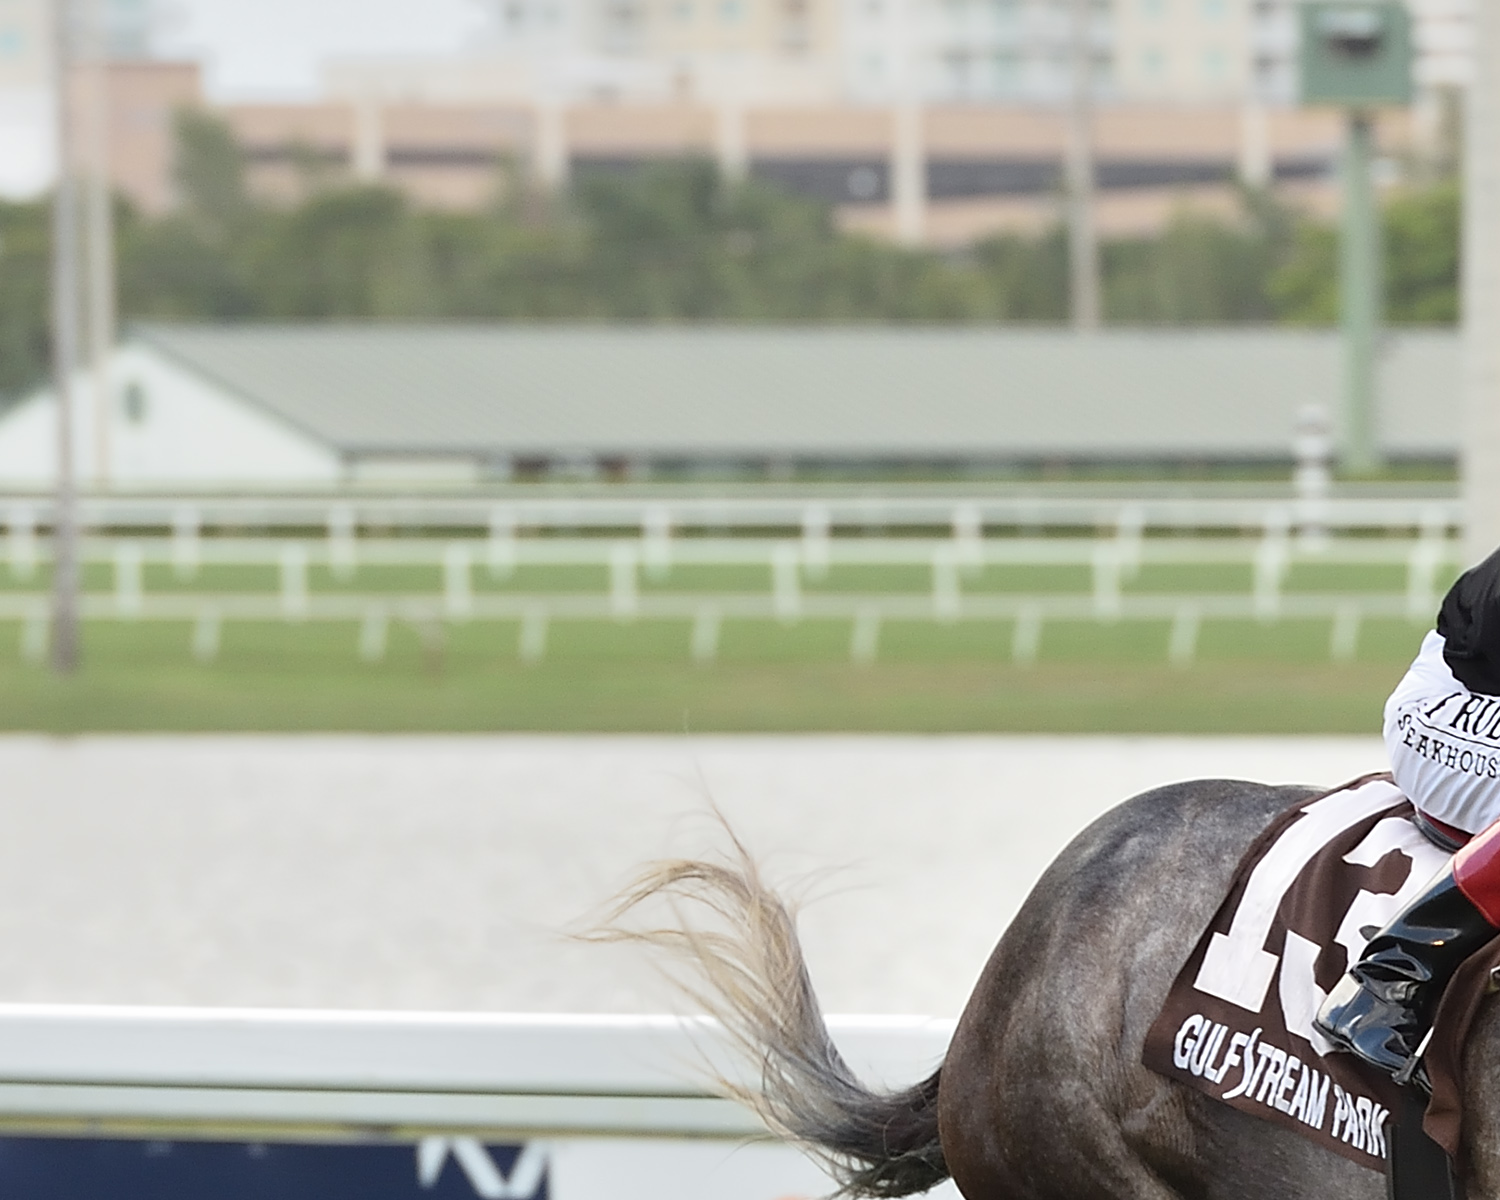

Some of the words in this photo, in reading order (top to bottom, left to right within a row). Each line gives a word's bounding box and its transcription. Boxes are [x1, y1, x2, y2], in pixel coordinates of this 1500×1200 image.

[1193, 780, 1456, 1058] 13
[1173, 1013, 1331, 1129] GULFSTREAM
[1331, 1083, 1391, 1160] PARK
